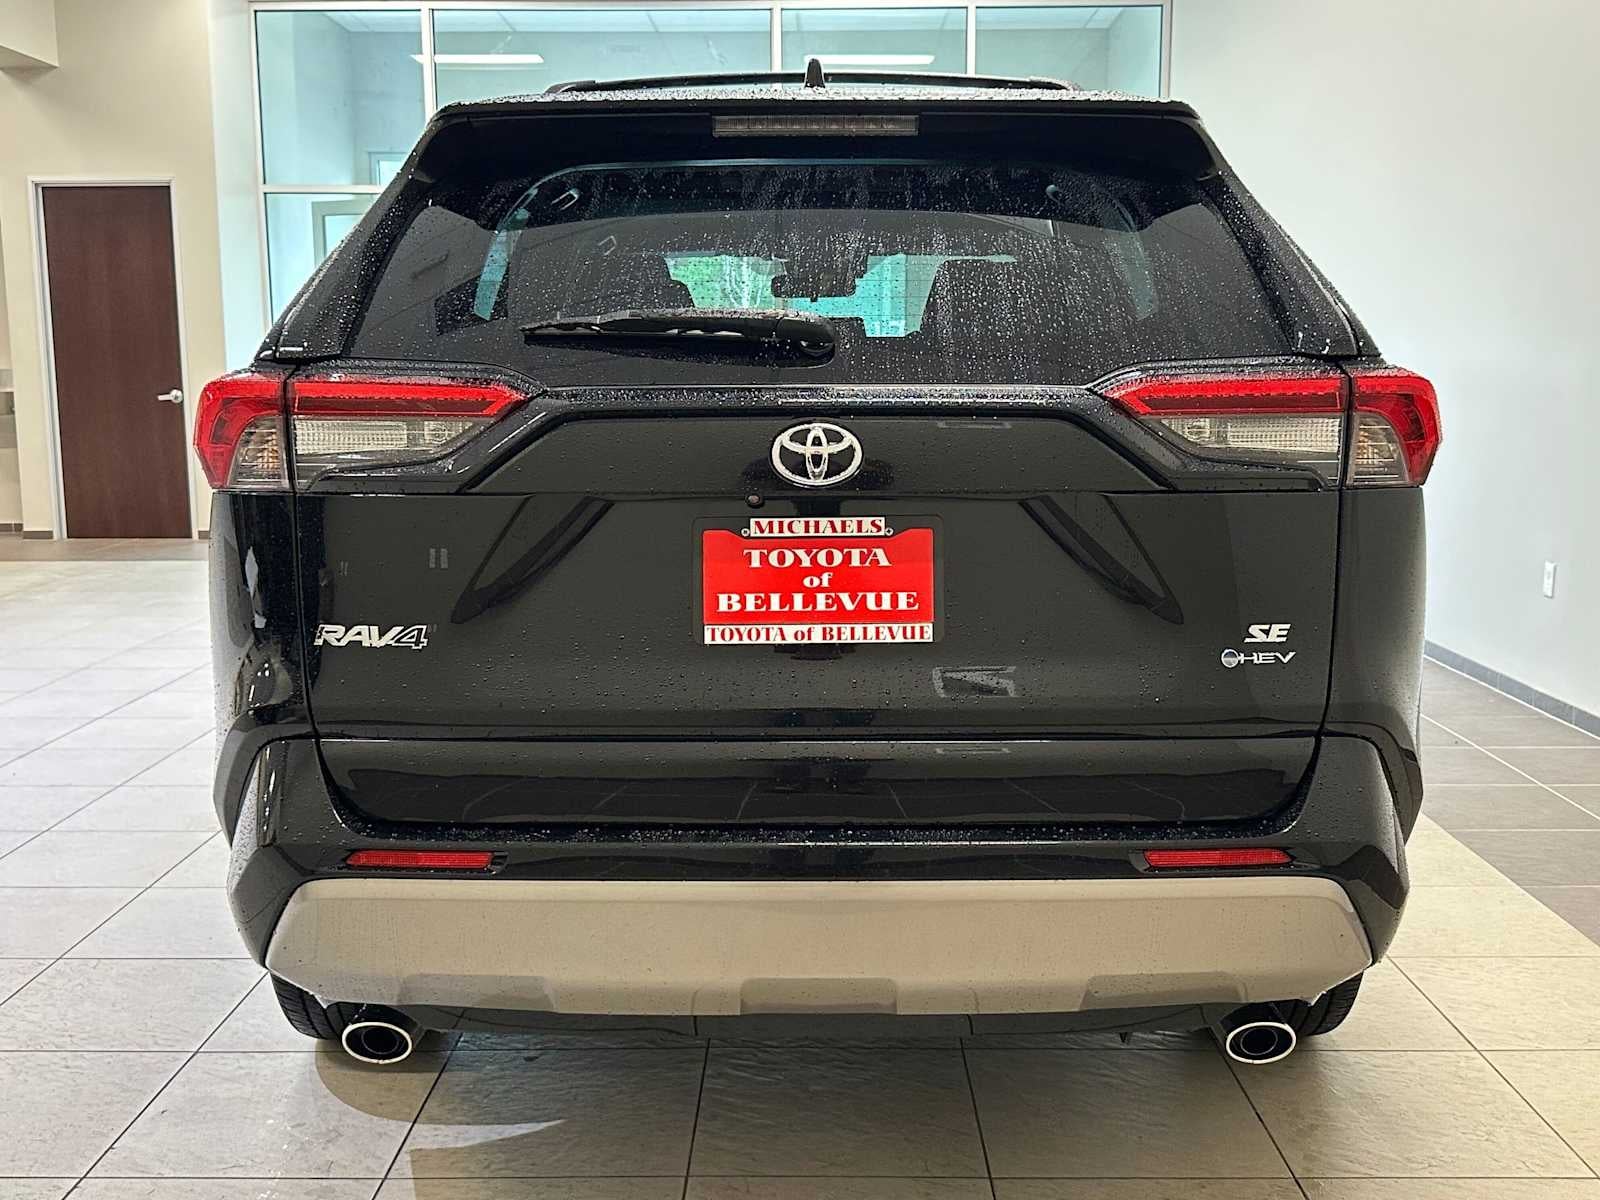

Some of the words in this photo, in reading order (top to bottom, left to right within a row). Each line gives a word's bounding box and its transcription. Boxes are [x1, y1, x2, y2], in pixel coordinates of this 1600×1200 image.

[754, 519, 883, 534] MICHAELS
[743, 548, 892, 567] TOYOTA
[802, 572, 833, 588] of
[716, 592, 919, 612] BELLEVUE
[313, 624, 428, 649] RAV4
[706, 626, 786, 642] TOYOTA
[794, 626, 814, 641] of
[822, 626, 931, 641] BELLEVUE
[1244, 623, 1291, 643] SE
